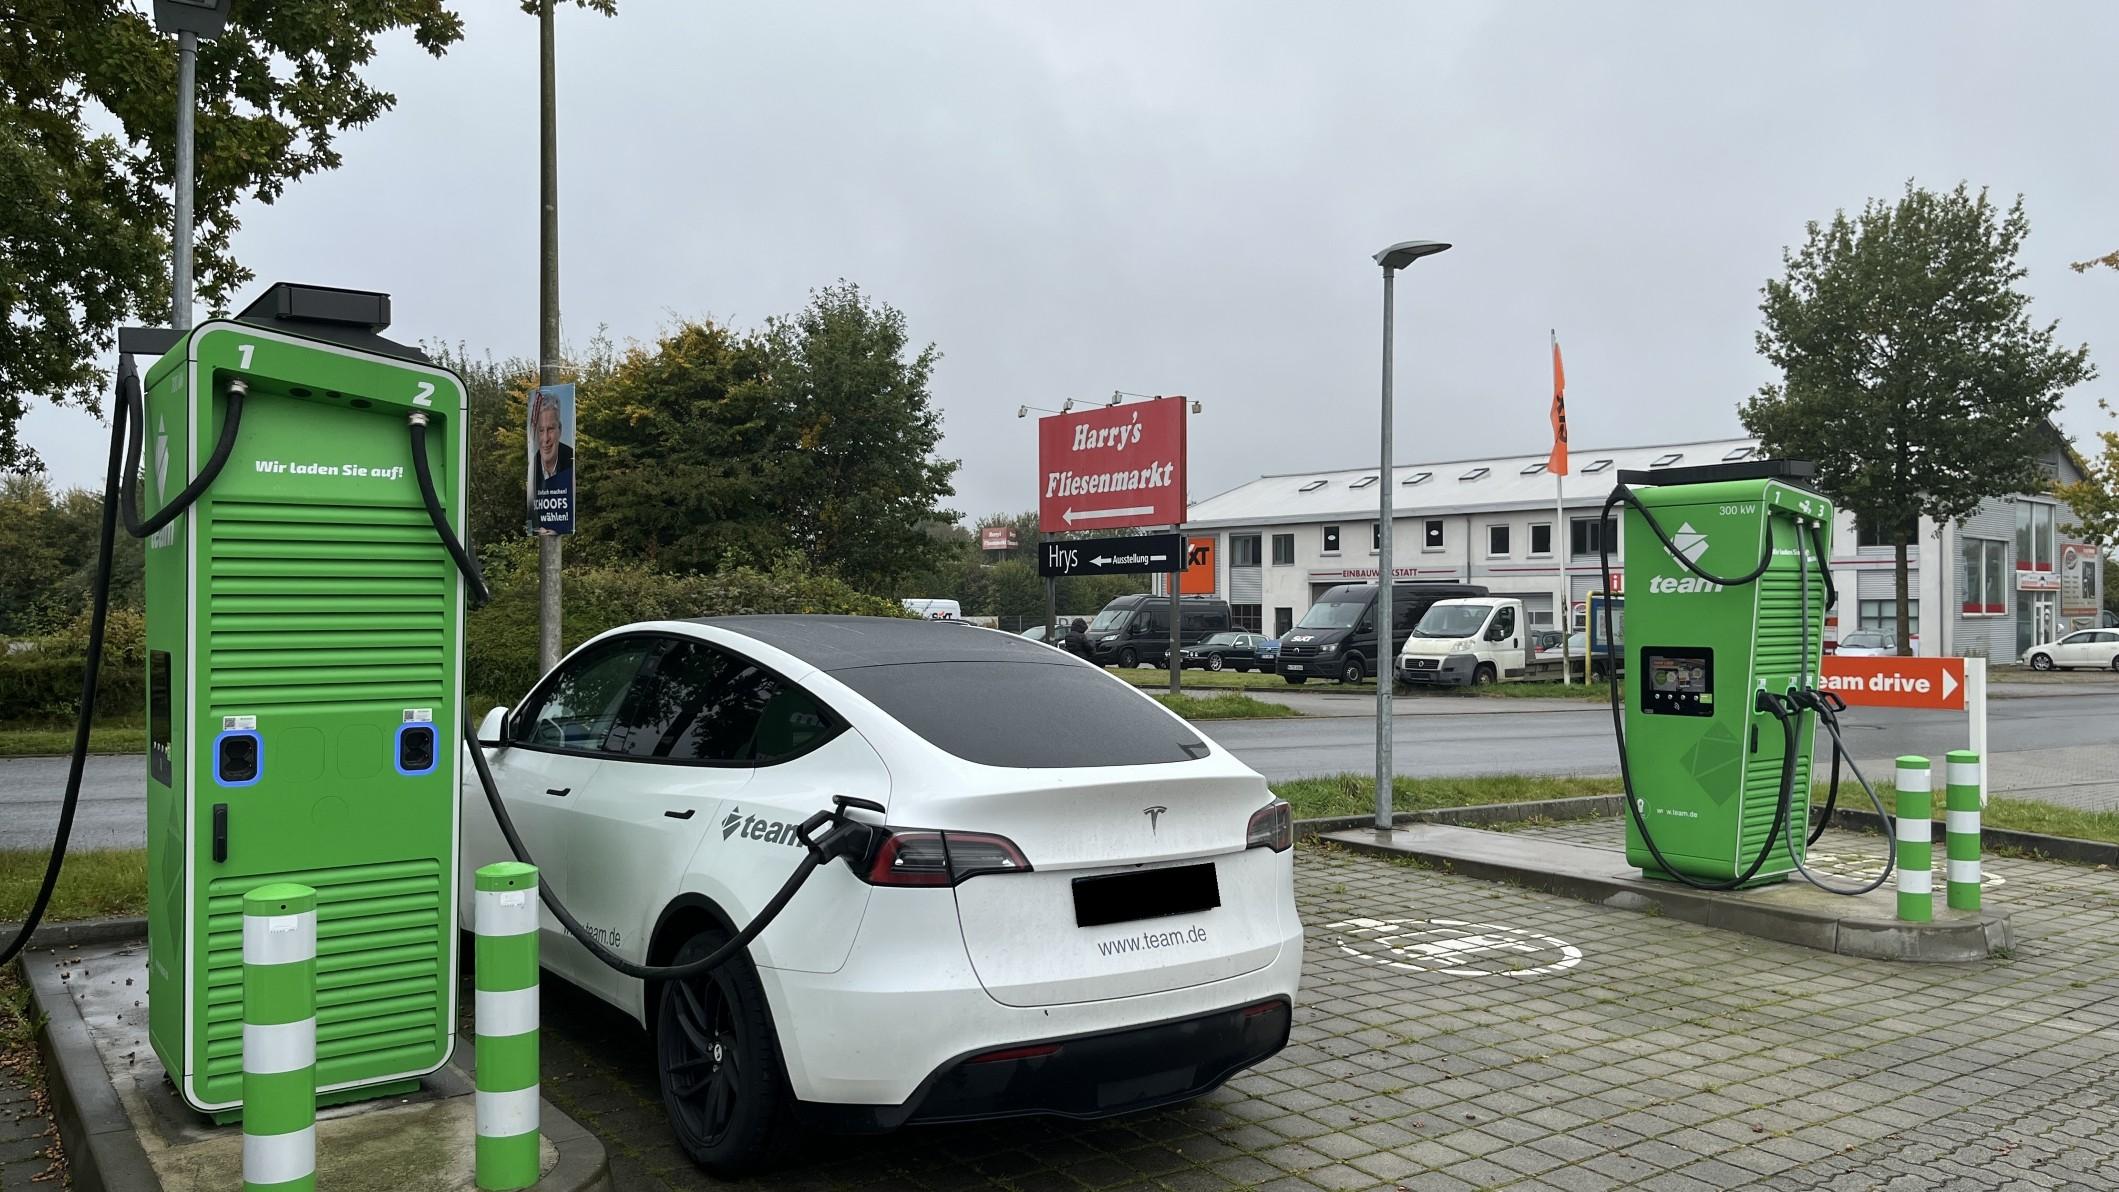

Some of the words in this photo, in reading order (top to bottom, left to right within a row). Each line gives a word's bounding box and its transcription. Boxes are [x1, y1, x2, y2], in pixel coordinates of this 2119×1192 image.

[238, 344, 255, 369] 1
[412, 381, 435, 407] 2
[1072, 411, 1142, 451] Harry's
[255, 460, 287, 473] Wir
[290, 462, 339, 476] laden
[342, 464, 368, 477] Sie
[371, 466, 404, 480] auf!
[1045, 460, 1174, 498] Fliesenmarkt
[1719, 505, 1738, 516] 300
[1740, 504, 1756, 515] kW
[1817, 504, 1825, 517] 3
[1049, 544, 1078, 574] Hrys
[1112, 553, 1149, 566] Ausstellung
[1342, 568, 1418, 578] EINBAUWKSTATT
[1819, 675, 1864, 691] eam
[1868, 673, 1931, 693] drive
[1097, 924, 1208, 957] www.team.de
